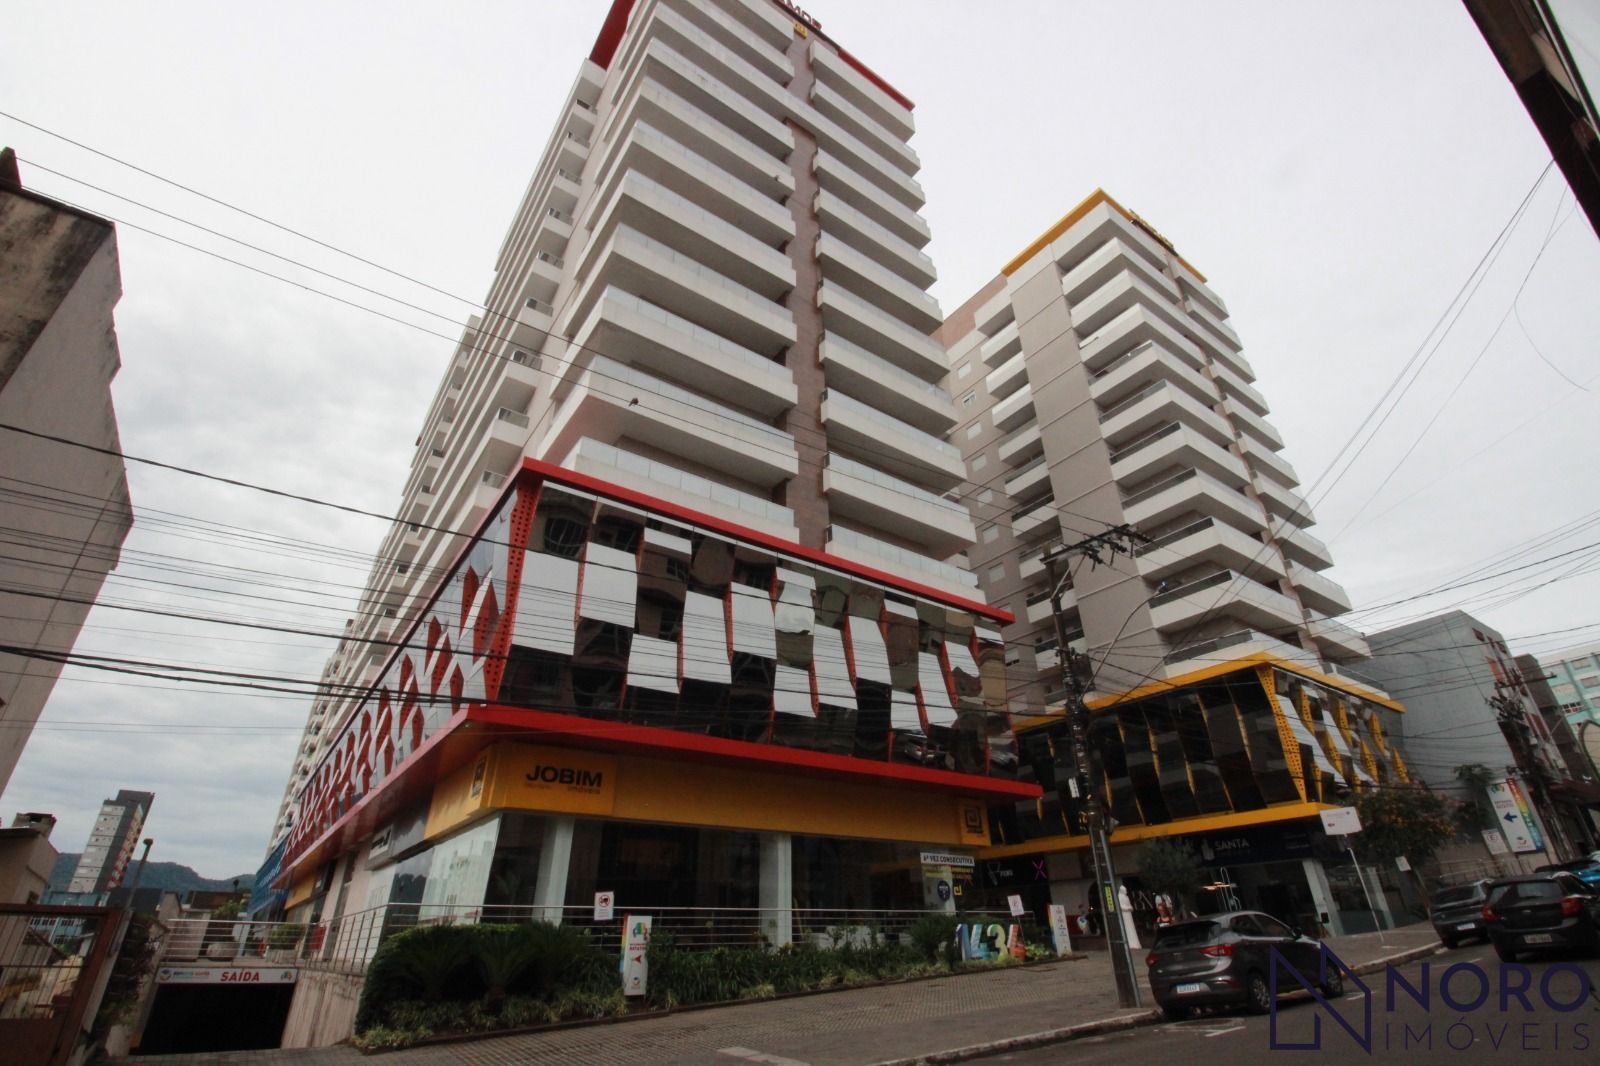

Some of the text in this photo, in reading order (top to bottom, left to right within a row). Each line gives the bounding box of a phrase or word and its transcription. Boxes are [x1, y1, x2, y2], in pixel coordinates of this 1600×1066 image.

[526, 764, 603, 787] JOBIM
[1214, 837, 1250, 850] SANTA
[930, 855, 939, 863] VEZ
[940, 855, 974, 865] CONSECUTIVA
[955, 923, 1026, 961] 1434
[221, 968, 260, 982] SAÍDA
